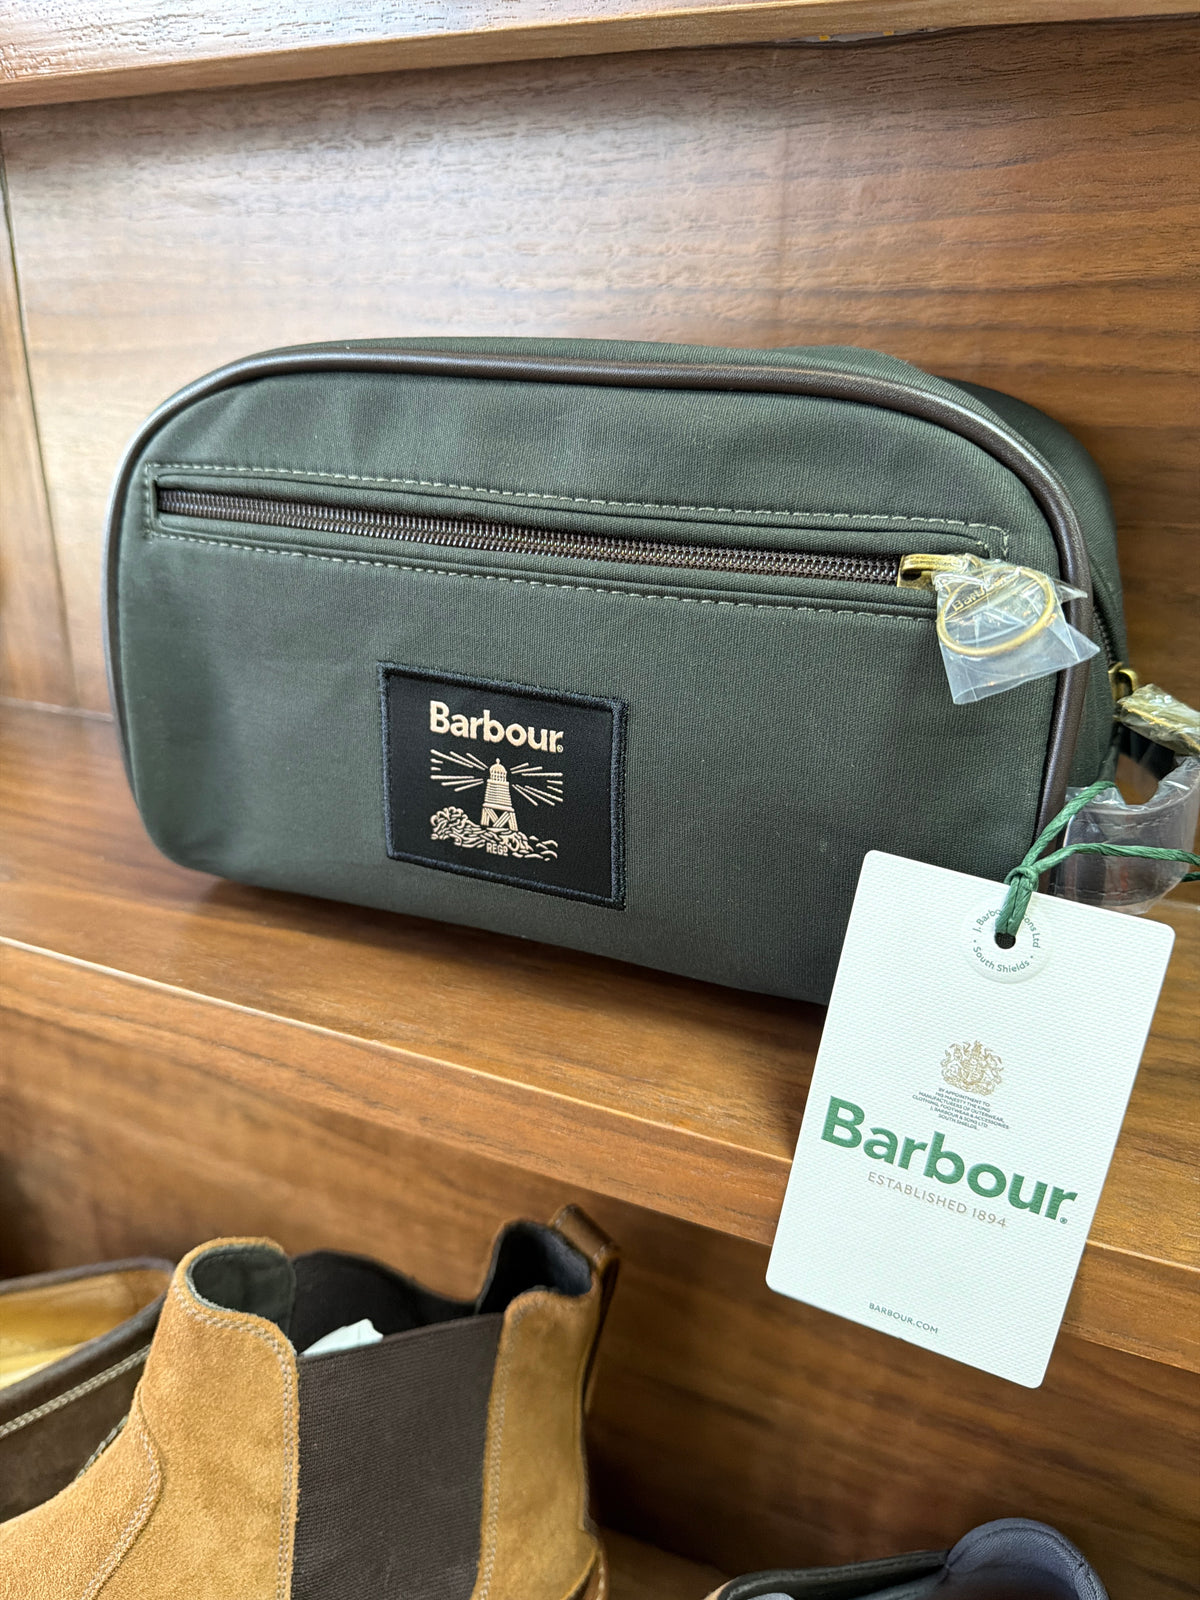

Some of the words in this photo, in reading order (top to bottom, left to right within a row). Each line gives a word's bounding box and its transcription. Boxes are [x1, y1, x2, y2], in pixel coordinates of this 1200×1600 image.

[1032, 932, 1041, 949] Ltd
[973, 946, 995, 970] South
[996, 960, 1030, 973] Shields
[868, 1171, 967, 1214] ESTABLISHED
[971, 1207, 1007, 1229] 1894
[868, 1302, 939, 1334] BARBOUR.COM
